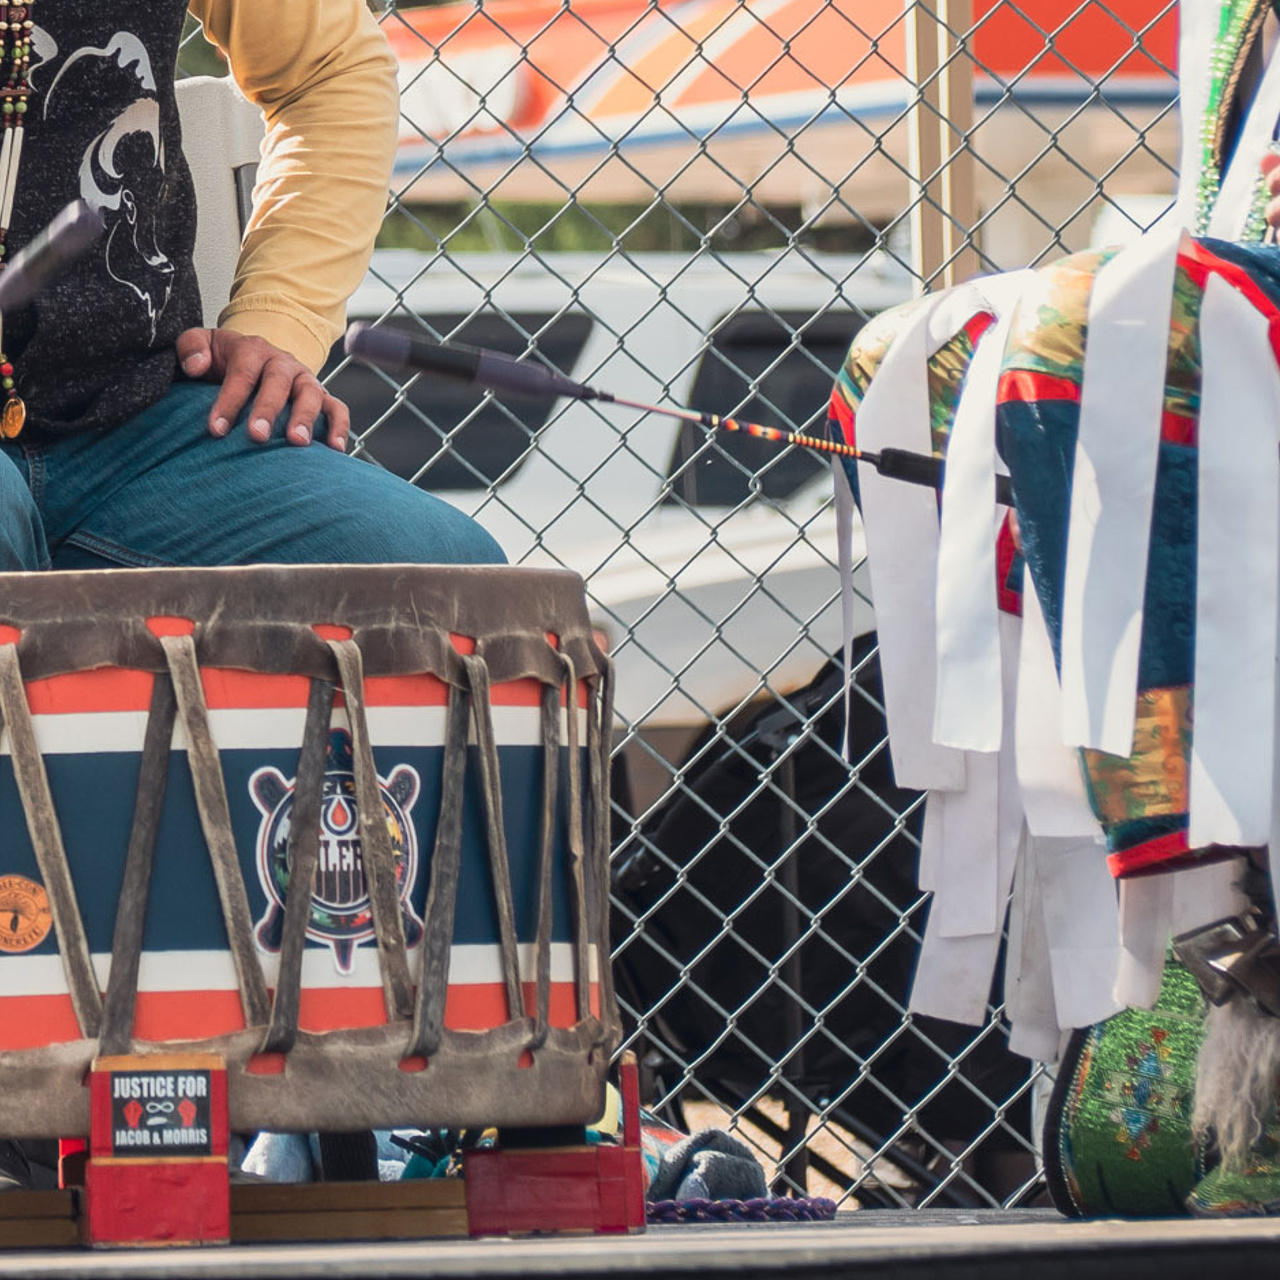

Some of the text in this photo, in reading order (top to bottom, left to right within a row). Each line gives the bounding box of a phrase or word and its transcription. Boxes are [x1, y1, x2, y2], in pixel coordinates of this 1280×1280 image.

[114, 1075, 208, 1099] JUSTICE FOR
[115, 1127, 208, 1147] JACOB & MORRIS
